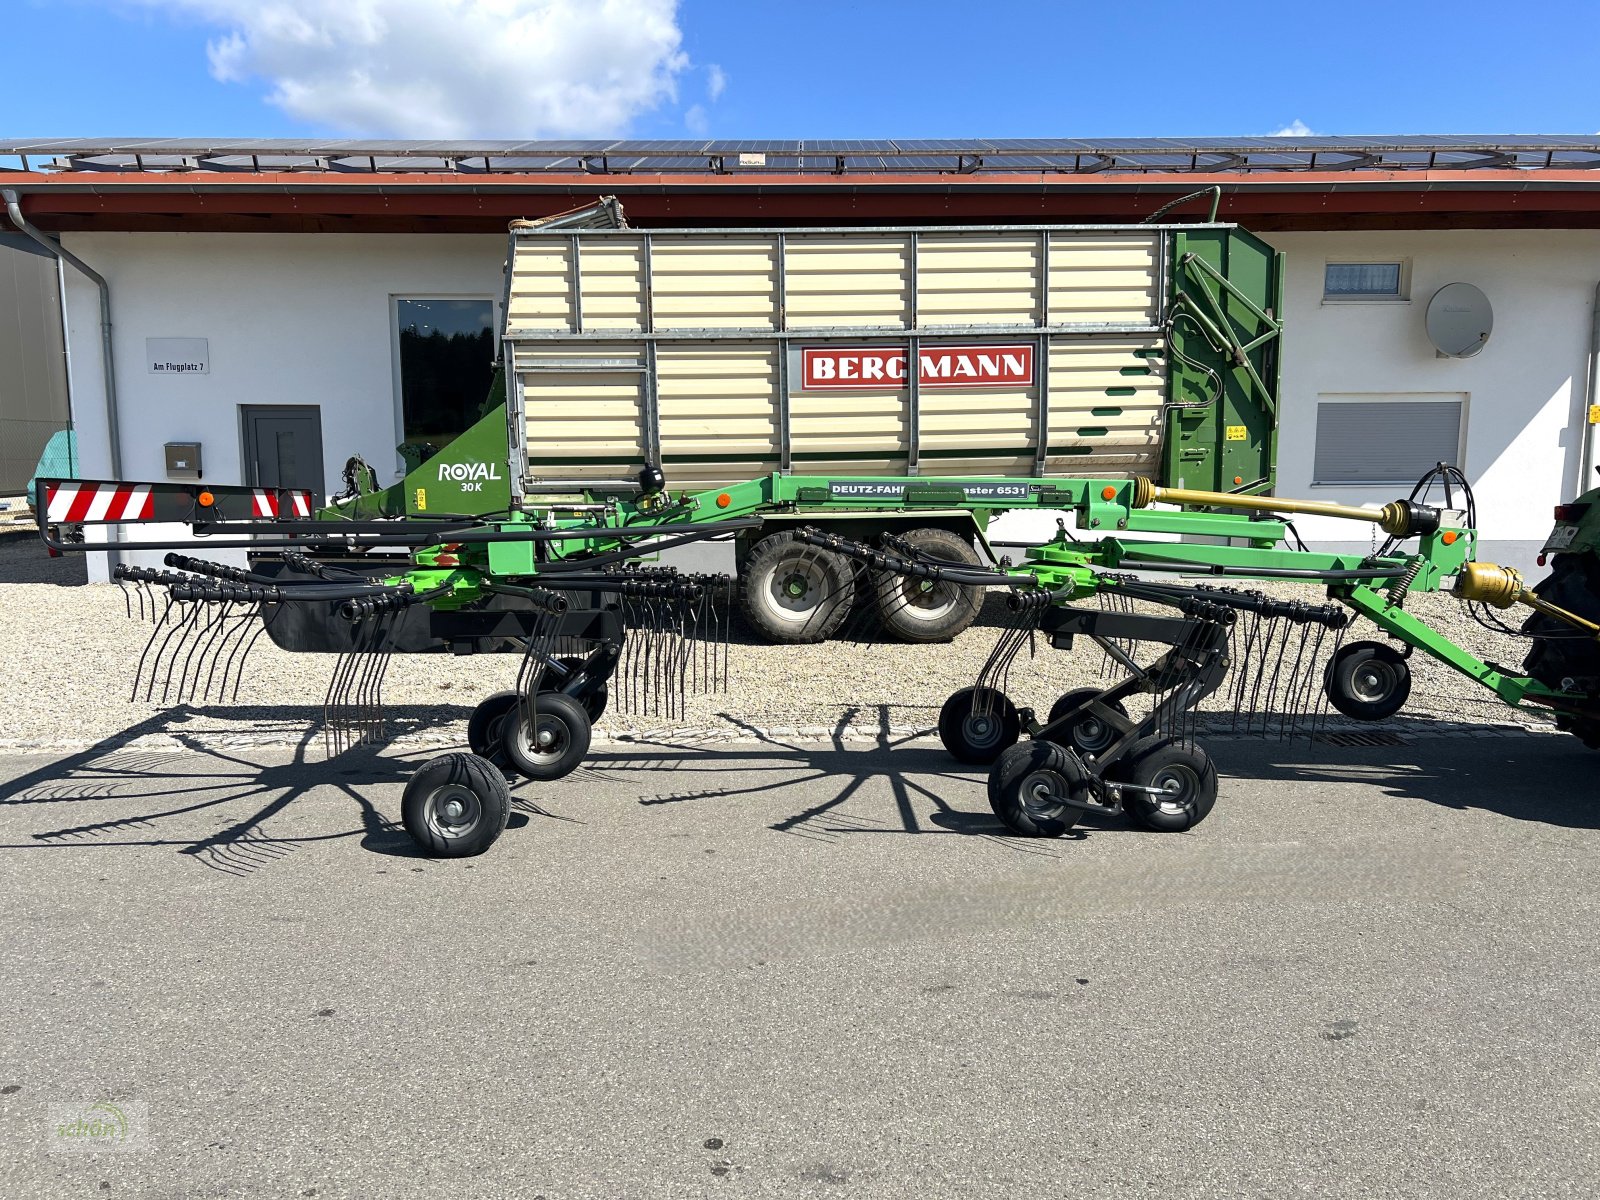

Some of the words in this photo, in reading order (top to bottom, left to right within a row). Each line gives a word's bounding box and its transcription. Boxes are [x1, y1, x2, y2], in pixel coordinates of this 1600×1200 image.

[153, 362, 164, 370] Am
[166, 362, 198, 372] Flugplatz
[199, 362, 204, 370] 7
[811, 353, 1025, 380] BERGMANN
[438, 462, 502, 481] ROYAL
[460, 482, 474, 492] 30
[474, 482, 482, 492] K
[996, 486, 1026, 495] 6531
